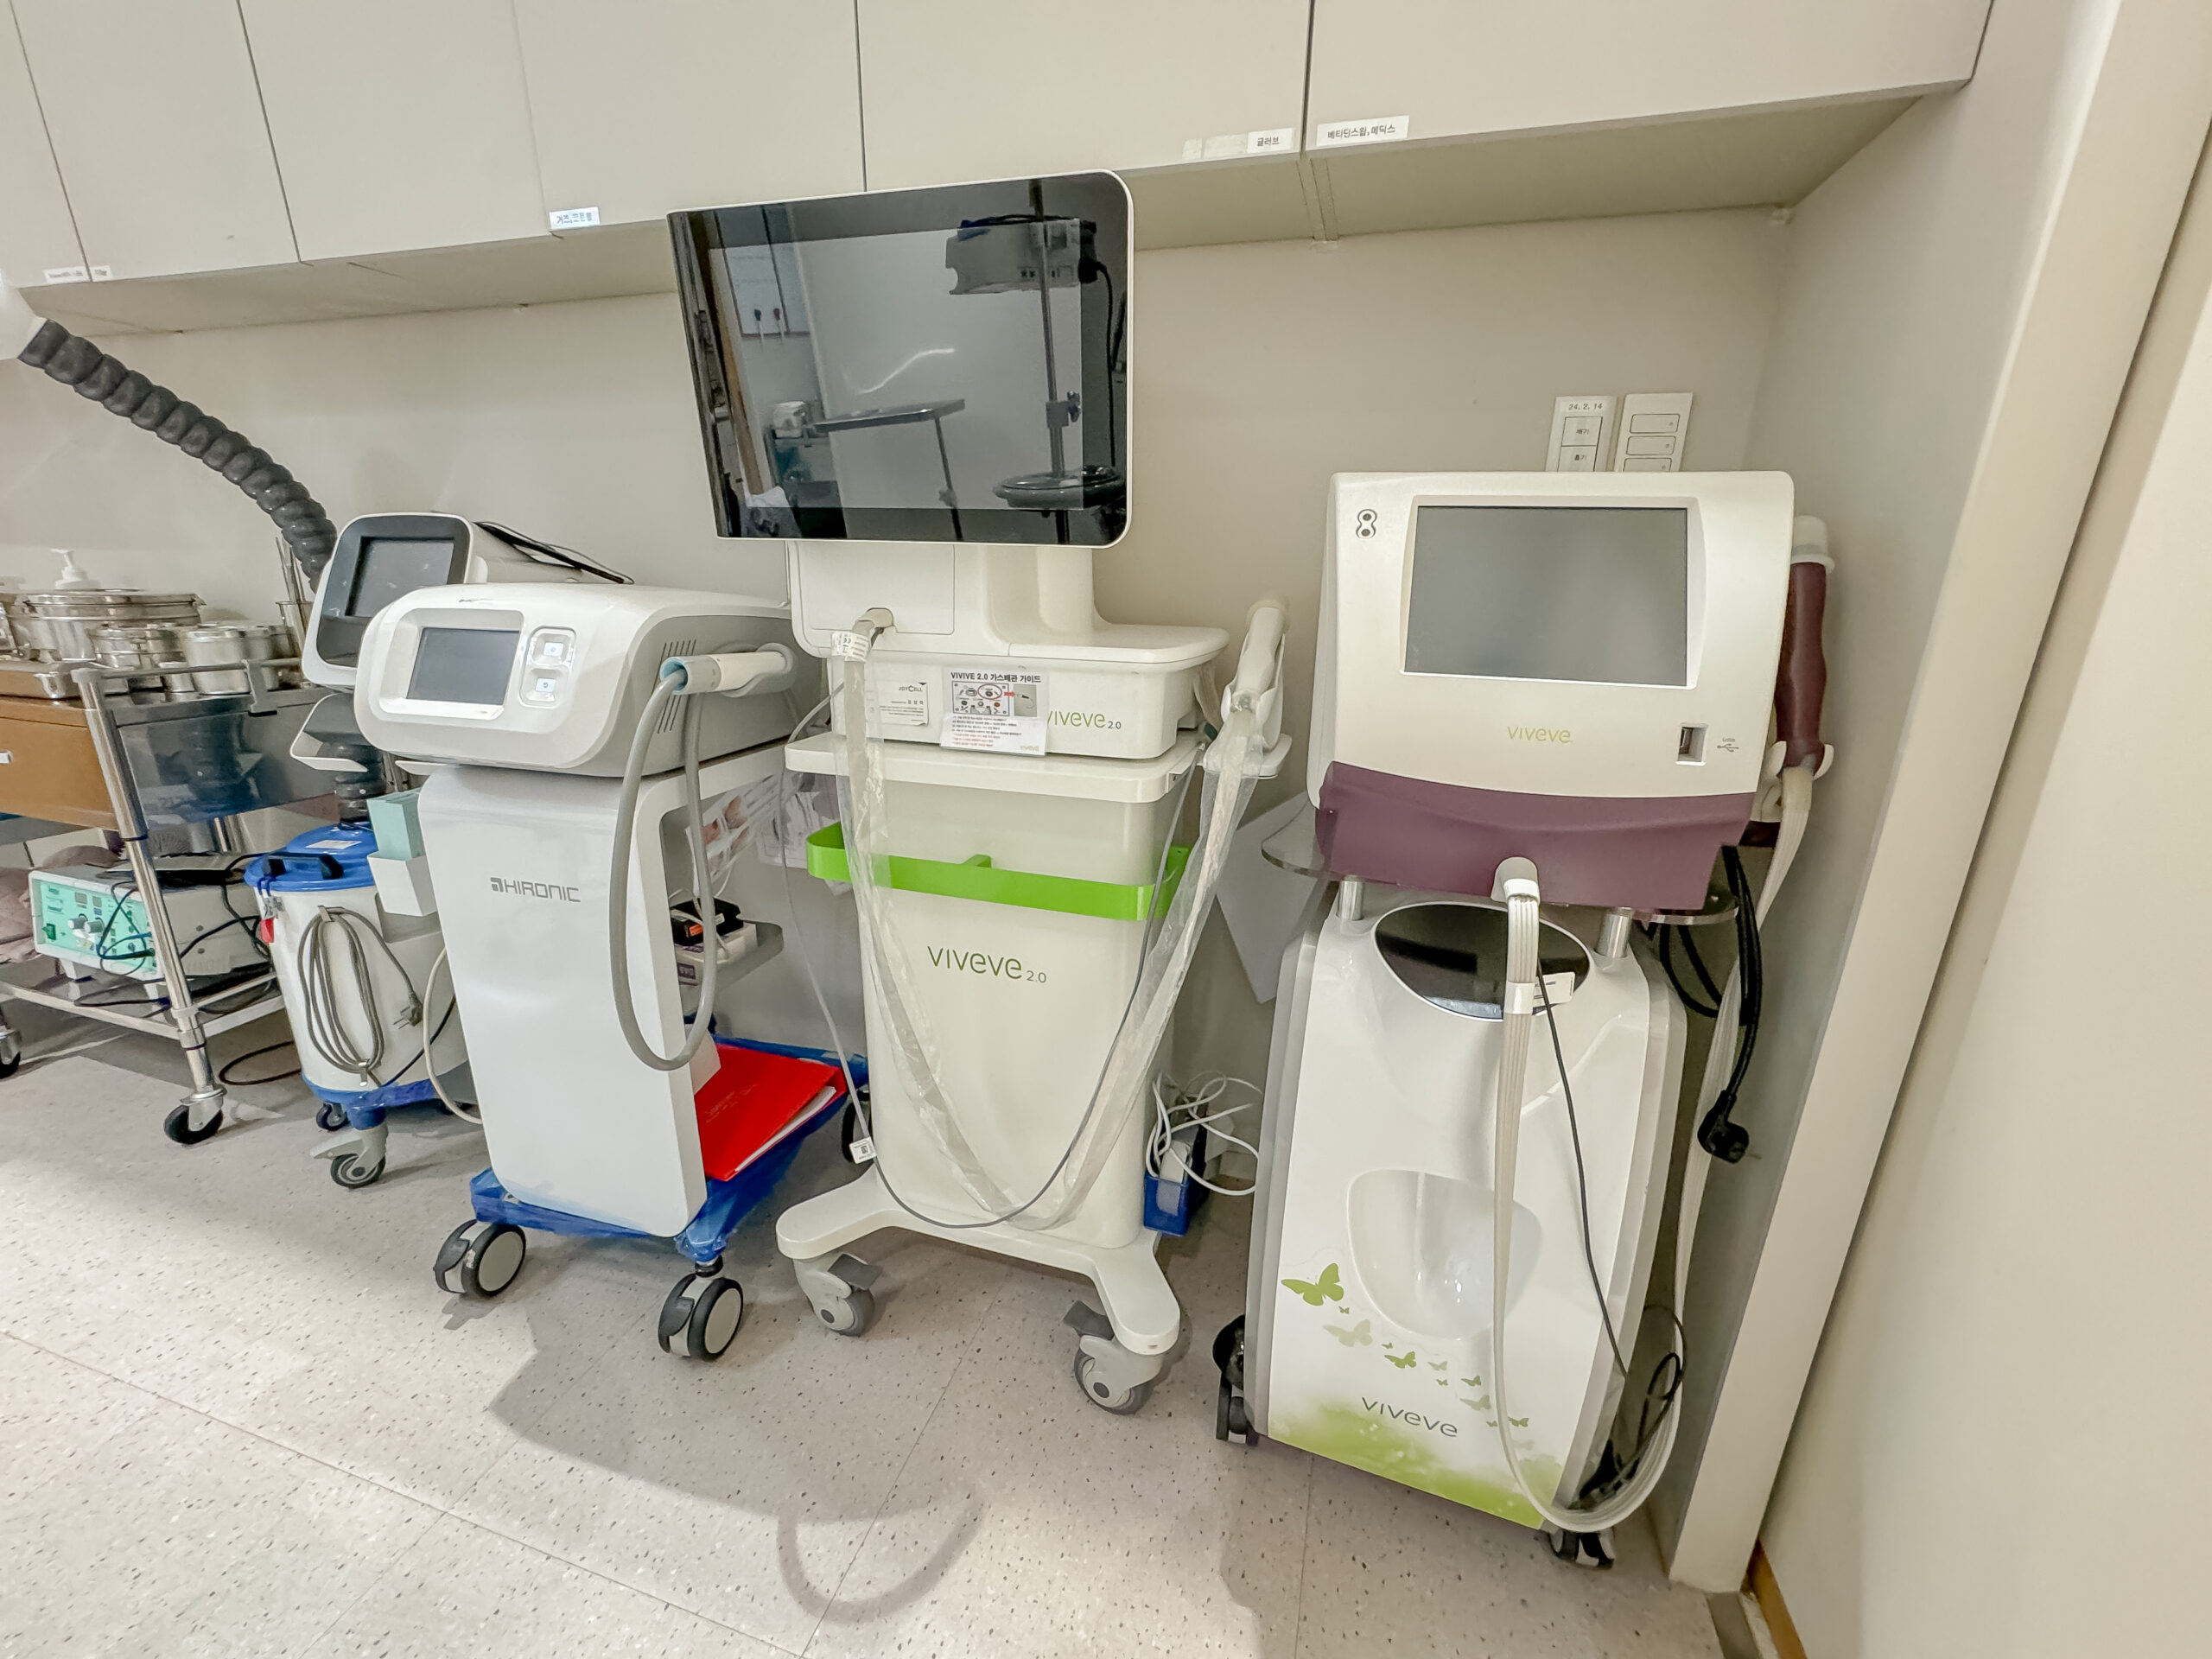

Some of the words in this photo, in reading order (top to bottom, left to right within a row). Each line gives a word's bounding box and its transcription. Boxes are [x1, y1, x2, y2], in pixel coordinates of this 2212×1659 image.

[1107, 721, 1122, 729] 2.0
[1507, 725, 1573, 744] viveve
[504, 878, 582, 903] HIRONIC
[927, 945, 1022, 980] viveve
[1027, 970, 1047, 983] 2.0
[1362, 1396, 1458, 1437] viveve
